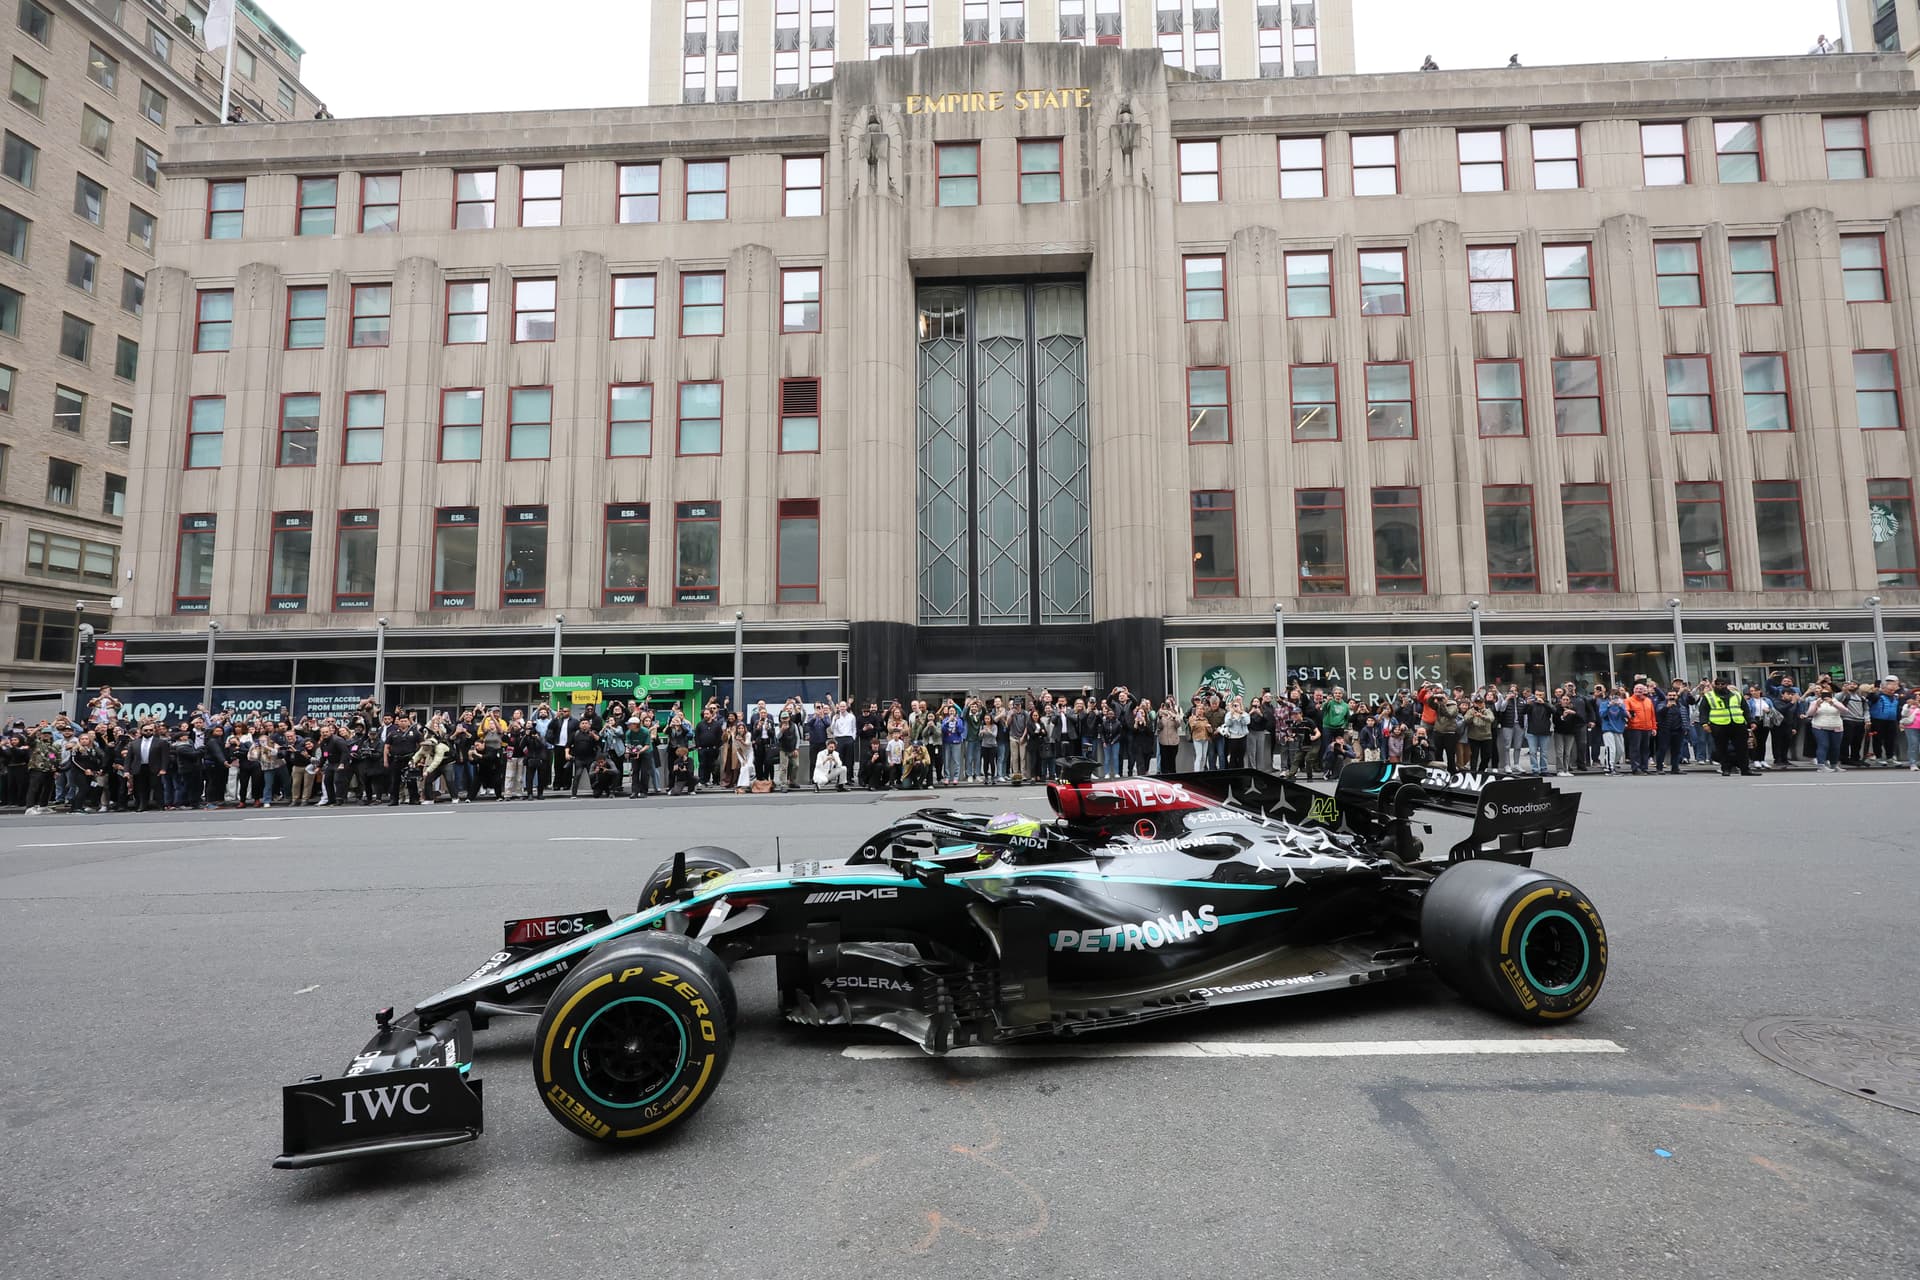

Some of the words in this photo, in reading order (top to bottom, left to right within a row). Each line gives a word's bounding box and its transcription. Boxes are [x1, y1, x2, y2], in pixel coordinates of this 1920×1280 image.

[906, 91, 1005, 114] EMPIRE
[1014, 88, 1092, 111] STATE
[194, 520, 207, 528] ESB
[443, 598, 464, 606] NOW
[614, 595, 635, 603] NOW
[1726, 622, 1784, 631] STARBUCKS
[1786, 621, 1830, 630] RESERVE
[1298, 665, 1441, 681] STARBUCKS
[555, 680, 591, 689] WhatsApp
[596, 677, 609, 688] Pit
[610, 677, 633, 689] Stop
[575, 693, 591, 701] Here
[221, 700, 263, 712] 15,000
[265, 700, 282, 710] SF
[1111, 783, 1190, 810] INEOS
[1309, 798, 1339, 822] 44
[1501, 801, 1551, 815] Snapdragon
[1199, 810, 1243, 823] SOLERA
[1009, 837, 1037, 848] AMD
[1126, 836, 1218, 855] TeamViewer
[837, 887, 898, 901] AMG
[525, 917, 584, 939] INEOS
[1054, 903, 1219, 953] PETRONAS
[1556, 889, 1572, 899] P
[1576, 899, 1606, 965] ZERO
[504, 960, 569, 995] Einhell
[835, 975, 902, 991] SOLERA
[1211, 974, 1315, 994] TeamViewer
[1500, 958, 1538, 1010] PIRELLI
[618, 966, 644, 983] P
[651, 970, 716, 1042] ZERO
[341, 1082, 431, 1125] IWC
[546, 1084, 612, 1138] PIRELLI
